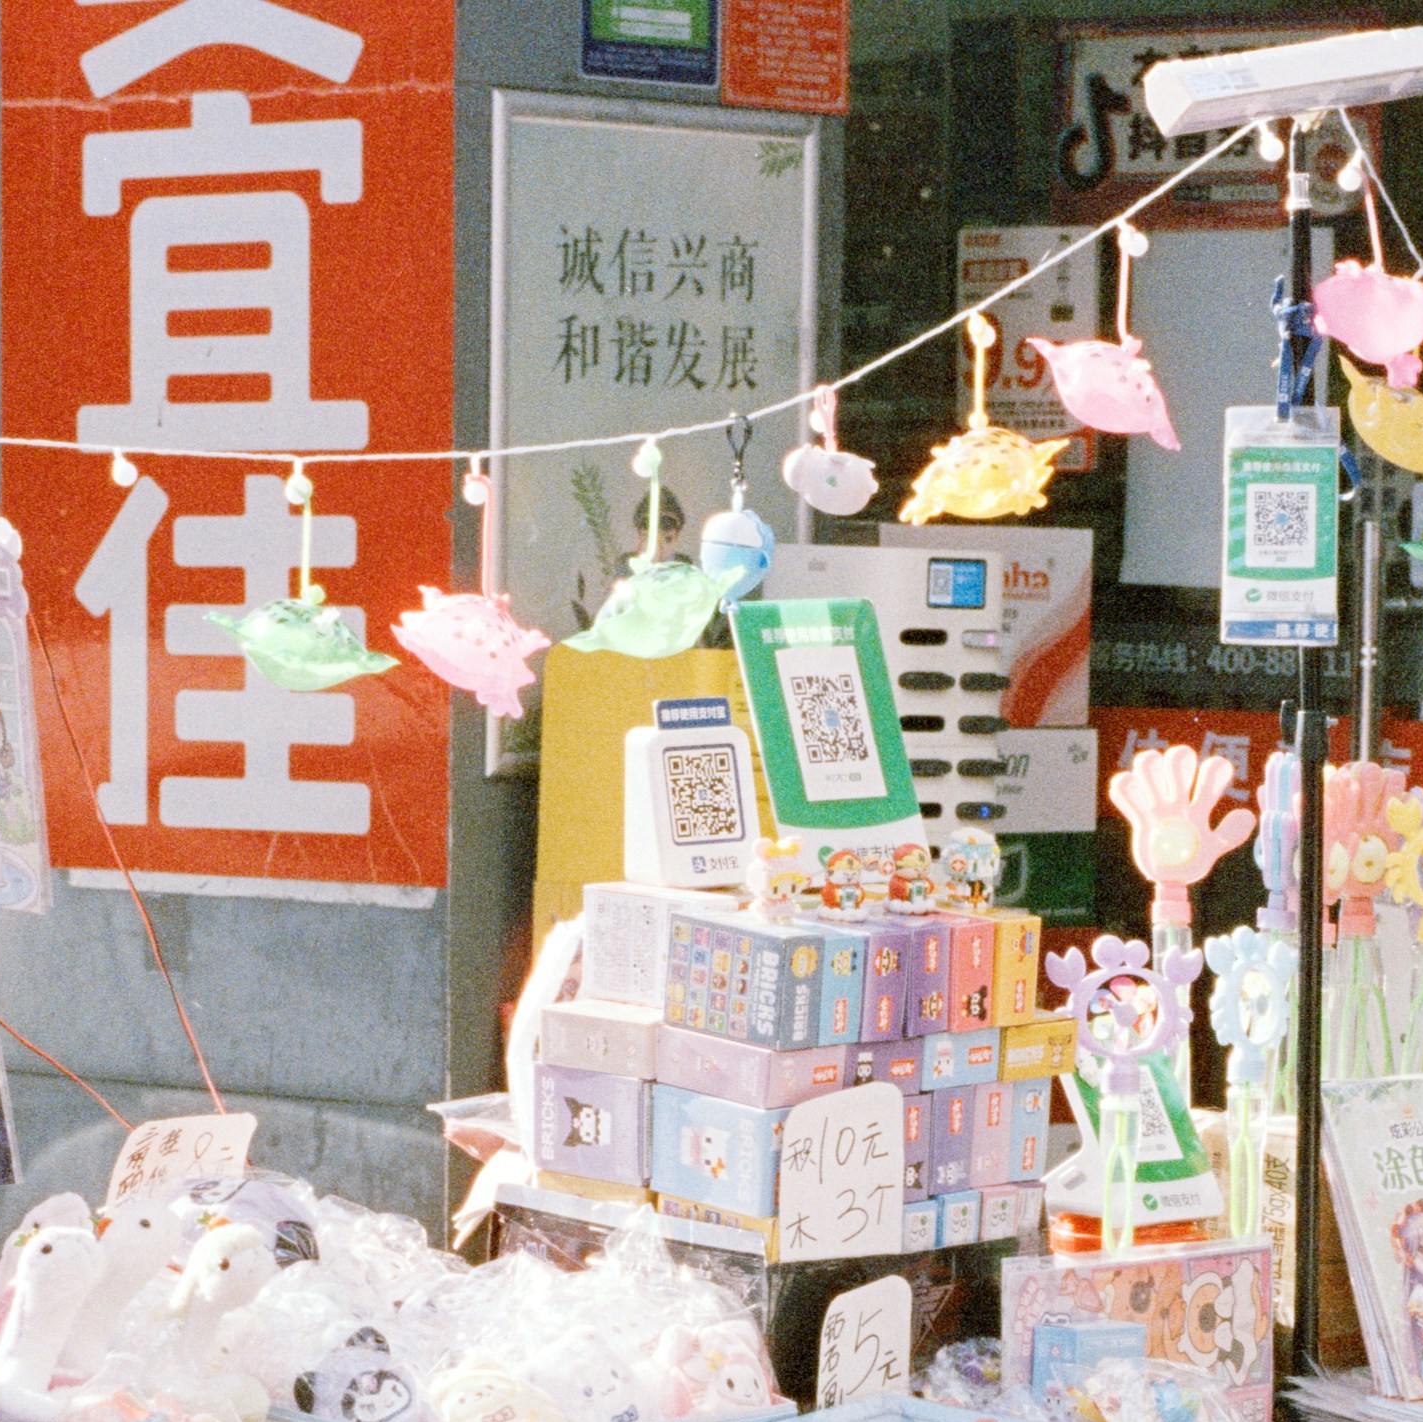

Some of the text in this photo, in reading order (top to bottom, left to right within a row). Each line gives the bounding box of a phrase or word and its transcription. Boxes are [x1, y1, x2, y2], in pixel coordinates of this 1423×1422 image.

[554, 225, 761, 304] 诚信兴商
[552, 314, 761, 393] 和谐发展
[1275, 622, 1338, 639] 推荐使
[710, 856, 739, 871] 支付宝
[755, 949, 780, 1036] BRICKS
[791, 984, 811, 1042] BRICKS
[541, 1076, 555, 1161] BRICKS
